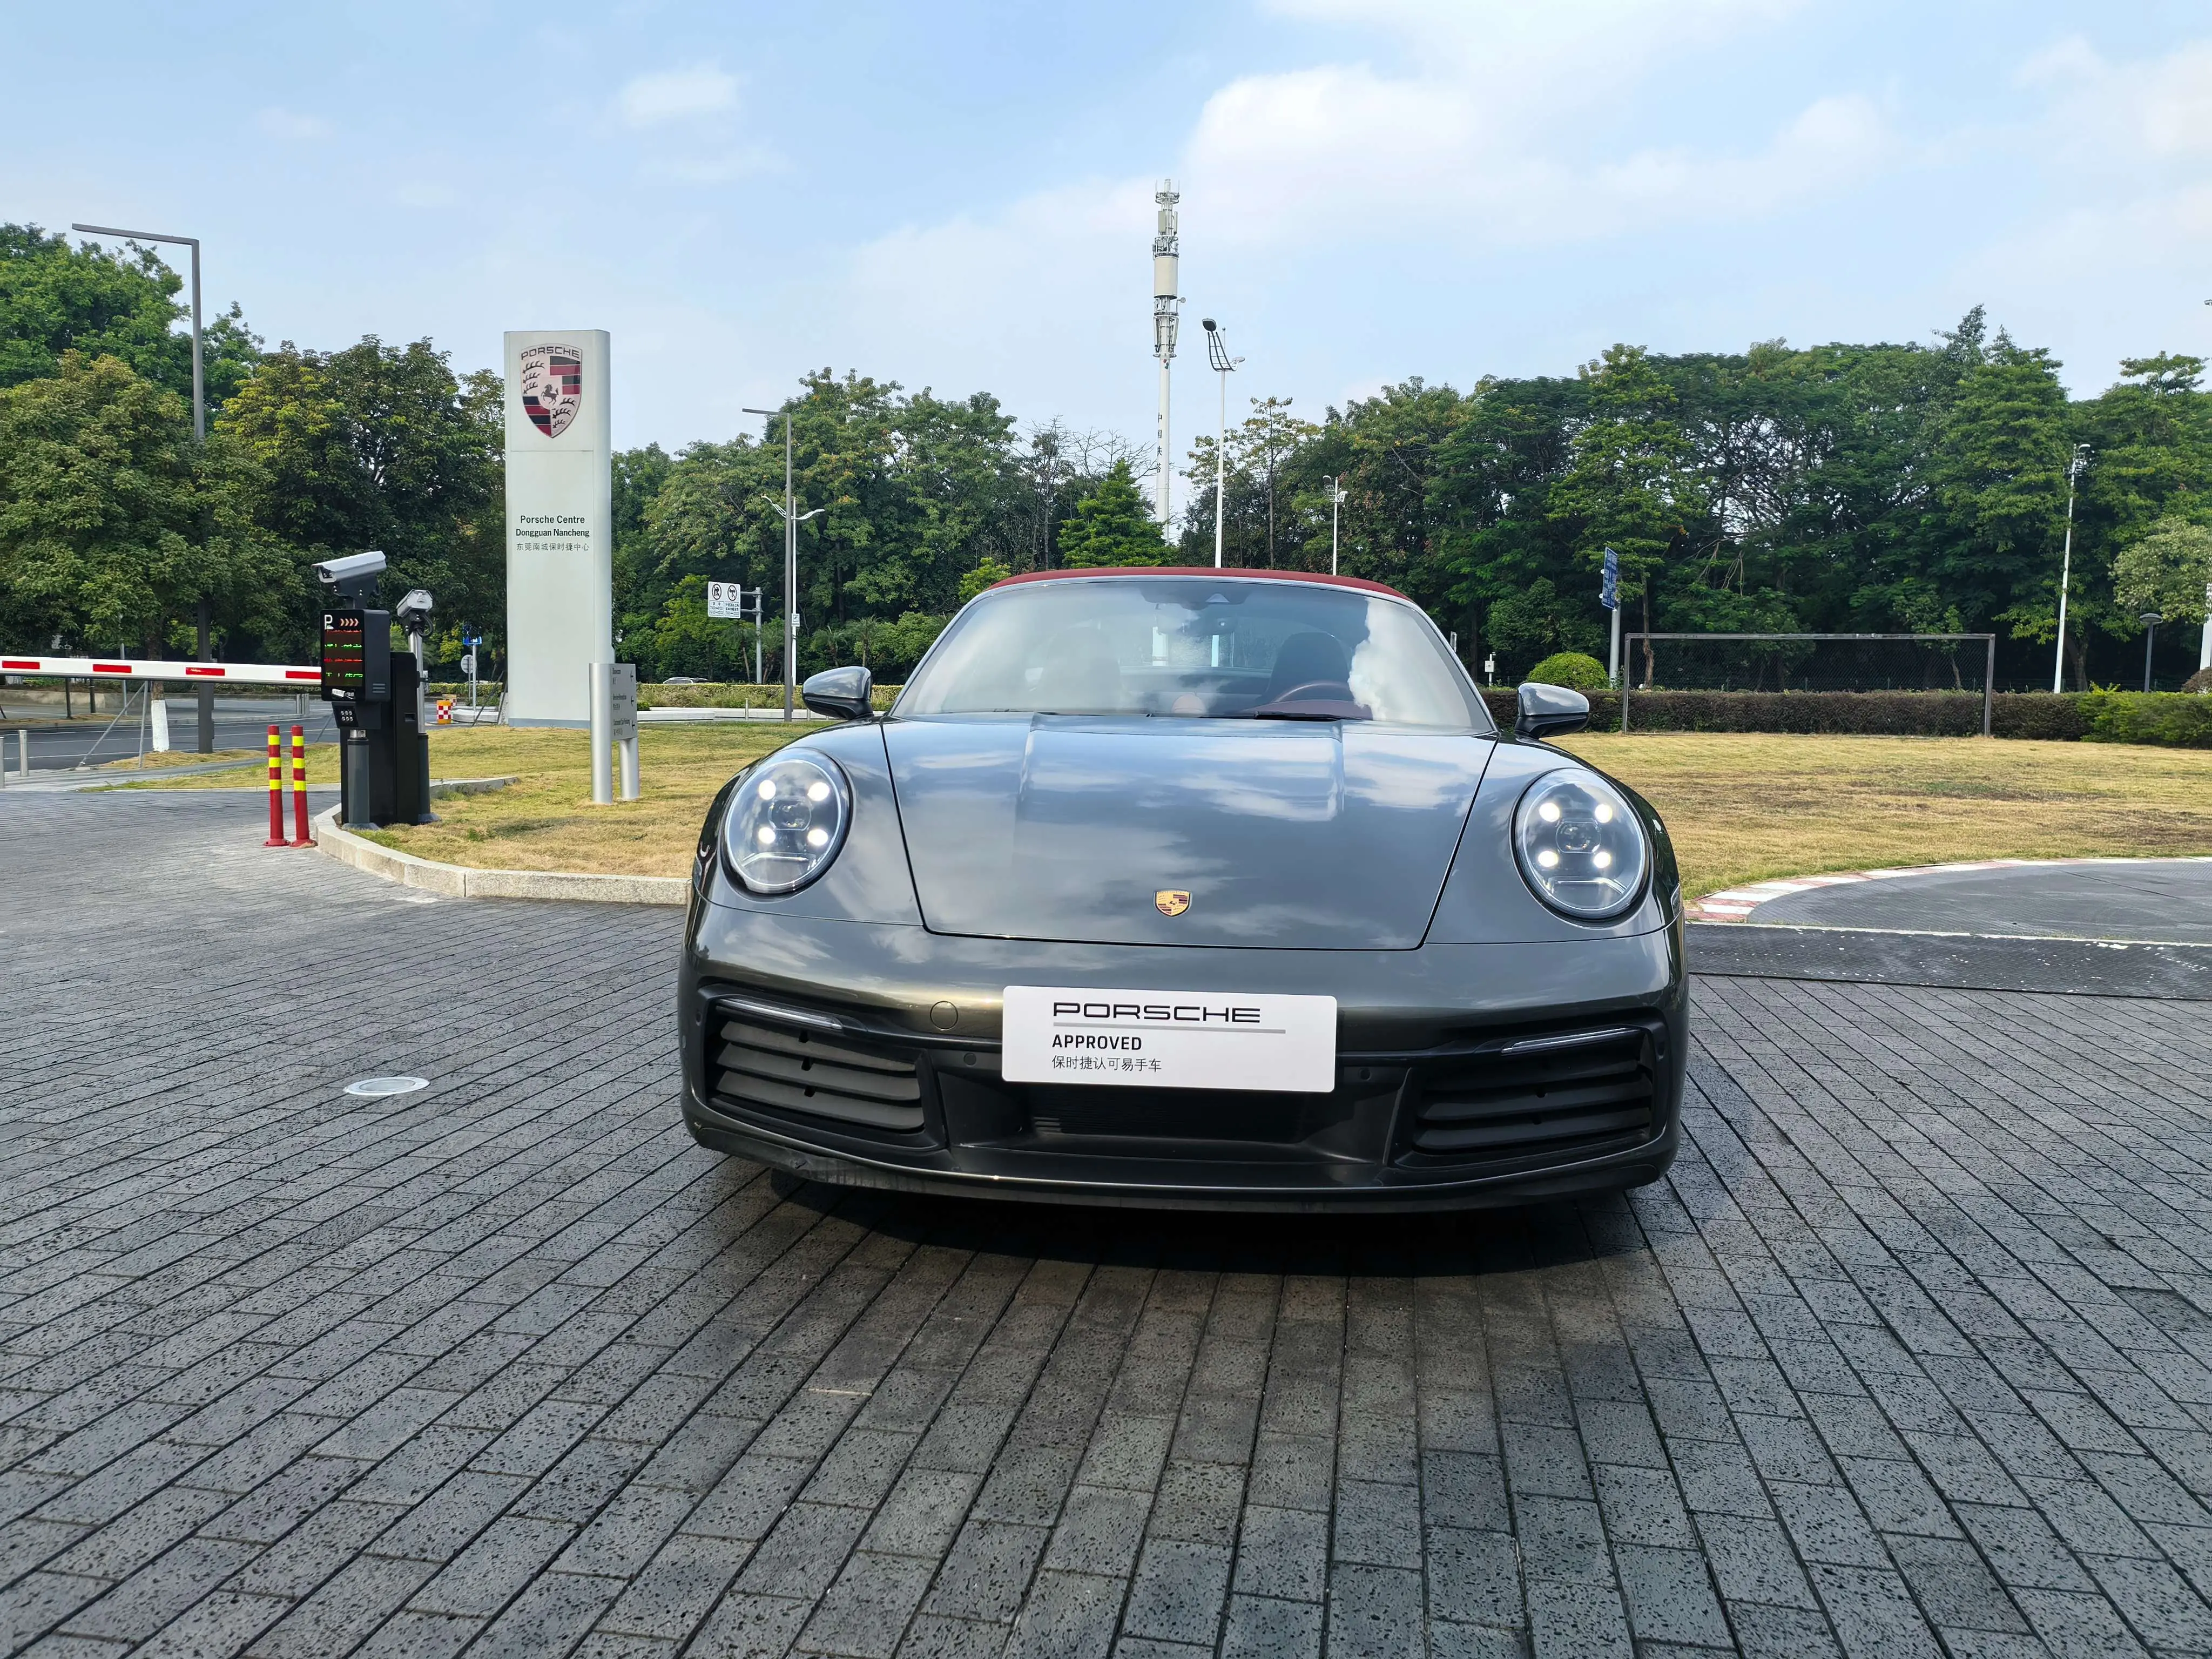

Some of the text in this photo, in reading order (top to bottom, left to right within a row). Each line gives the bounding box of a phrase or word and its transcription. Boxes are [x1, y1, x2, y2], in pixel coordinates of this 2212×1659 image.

[521, 346, 579, 360] PORSCHE
[520, 515, 585, 523] Porsche Centre
[516, 528, 590, 538] Dongguan Nancheng
[516, 542, 590, 551] 东莞南城保时捷中心
[1053, 1002, 1261, 1023] PORSCHE
[1052, 1034, 1142, 1051] APPROVED
[1051, 1055, 1162, 1073] 保时捷认可易手车
